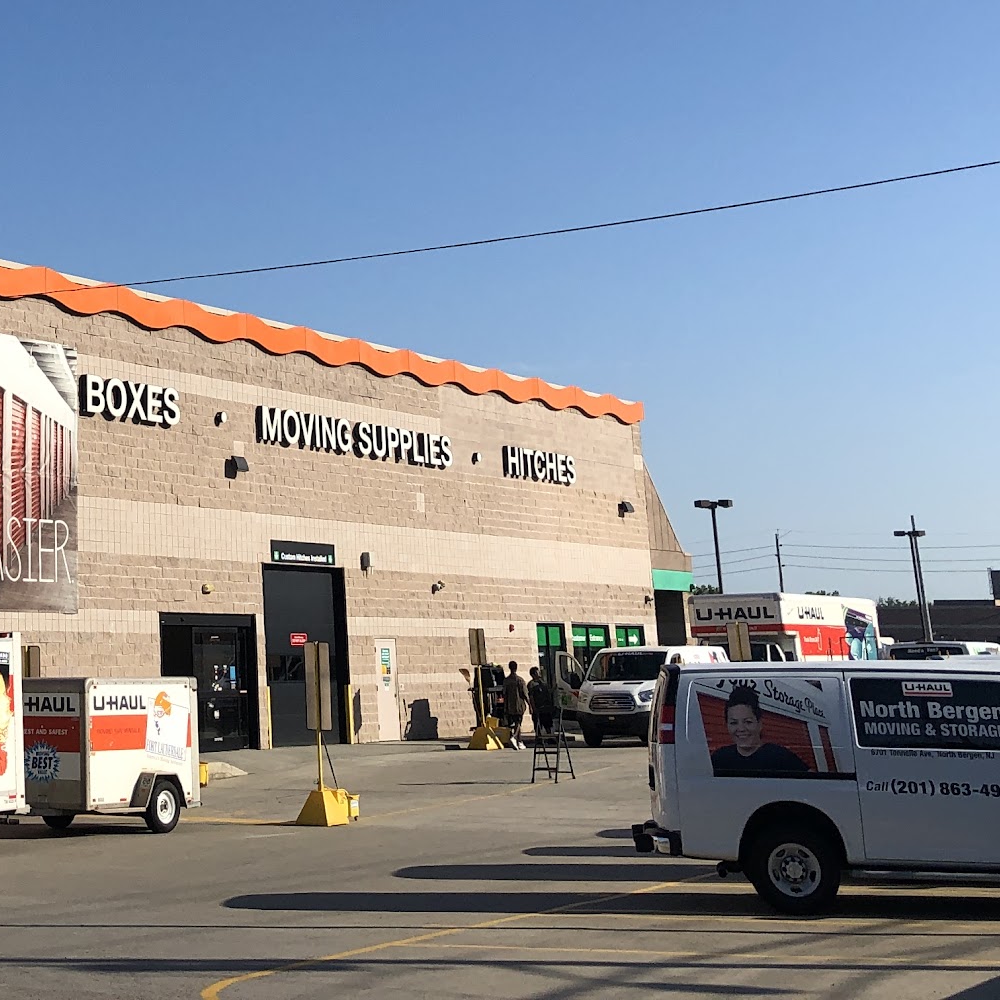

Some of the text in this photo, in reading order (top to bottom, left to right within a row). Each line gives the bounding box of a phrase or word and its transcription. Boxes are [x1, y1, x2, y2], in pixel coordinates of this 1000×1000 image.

[83, 374, 181, 427] BOXES
[257, 406, 453, 469] MOVING SUPPLIES
[504, 445, 577, 485] HITCHES
[696, 606, 775, 621] U-HAUL
[797, 606, 825, 620] U-HAUL
[904, 683, 950, 691] U-HAUL
[24, 696, 76, 712] -HAUL
[93, 694, 147, 711] U-HAUL
[859, 700, 920, 718] North
[864, 722, 920, 736] MOVING
[925, 723, 936, 736] &
[32, 756, 53, 770] BEST
[866, 780, 888, 792] Call
[890, 778, 936, 797] (201)
